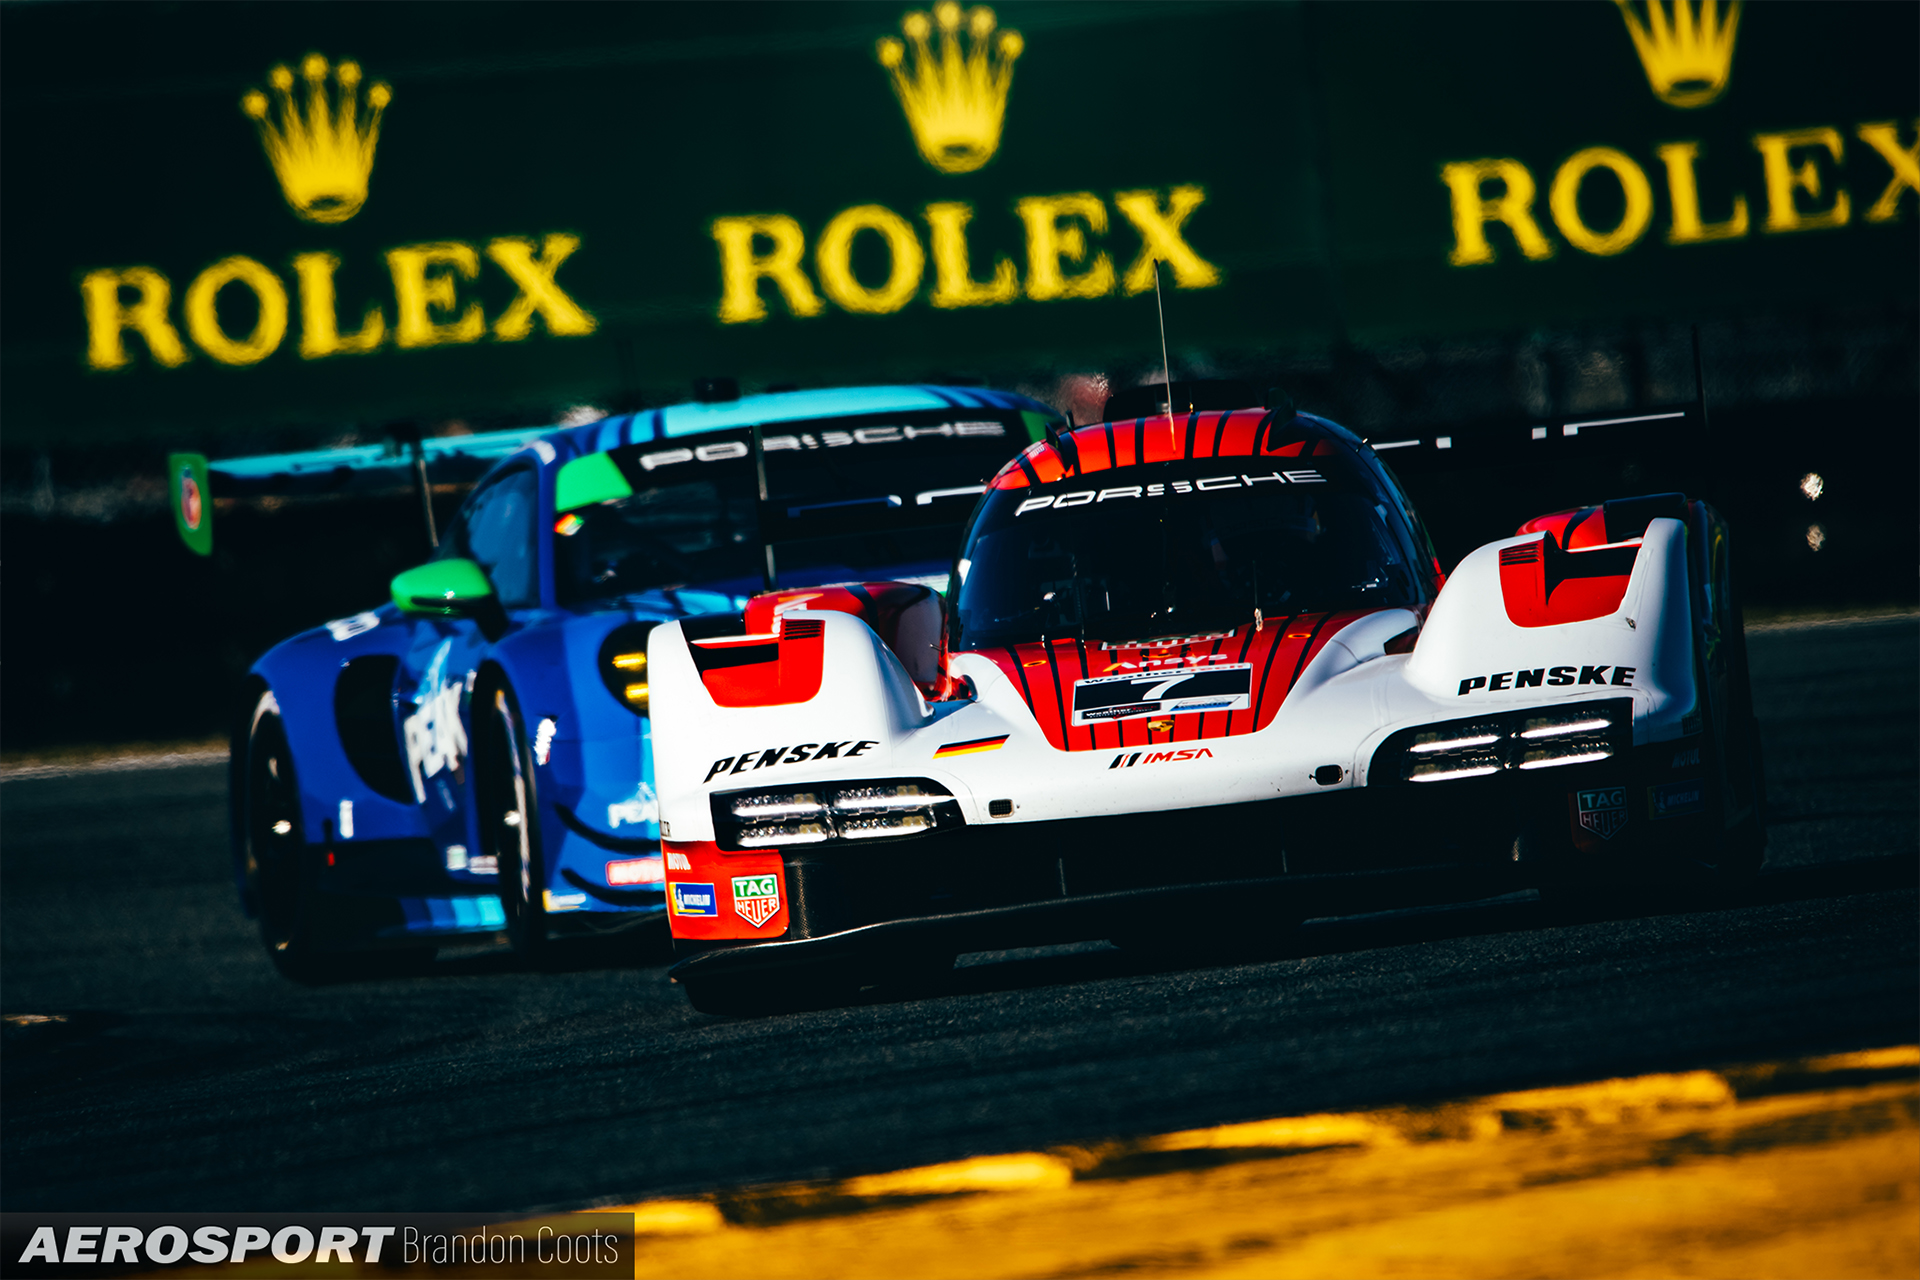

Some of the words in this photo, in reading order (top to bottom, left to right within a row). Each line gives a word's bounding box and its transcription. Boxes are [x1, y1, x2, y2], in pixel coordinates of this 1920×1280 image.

[1441, 119, 1920, 267] ROLEX
[712, 184, 1221, 324] ROLEX
[81, 233, 598, 370] ROLEX
[640, 421, 1005, 470] PORSCHE
[1014, 470, 1327, 516] PORSCHE
[1130, 674, 1196, 701] 7
[1457, 665, 1637, 696] PENSKE
[702, 740, 881, 784] PENSKE
[1142, 748, 1214, 765] IMSA
[1582, 790, 1623, 808] TAG
[1583, 810, 1626, 835] HEUER
[735, 878, 774, 896] TAG
[736, 898, 777, 924] HEUER
